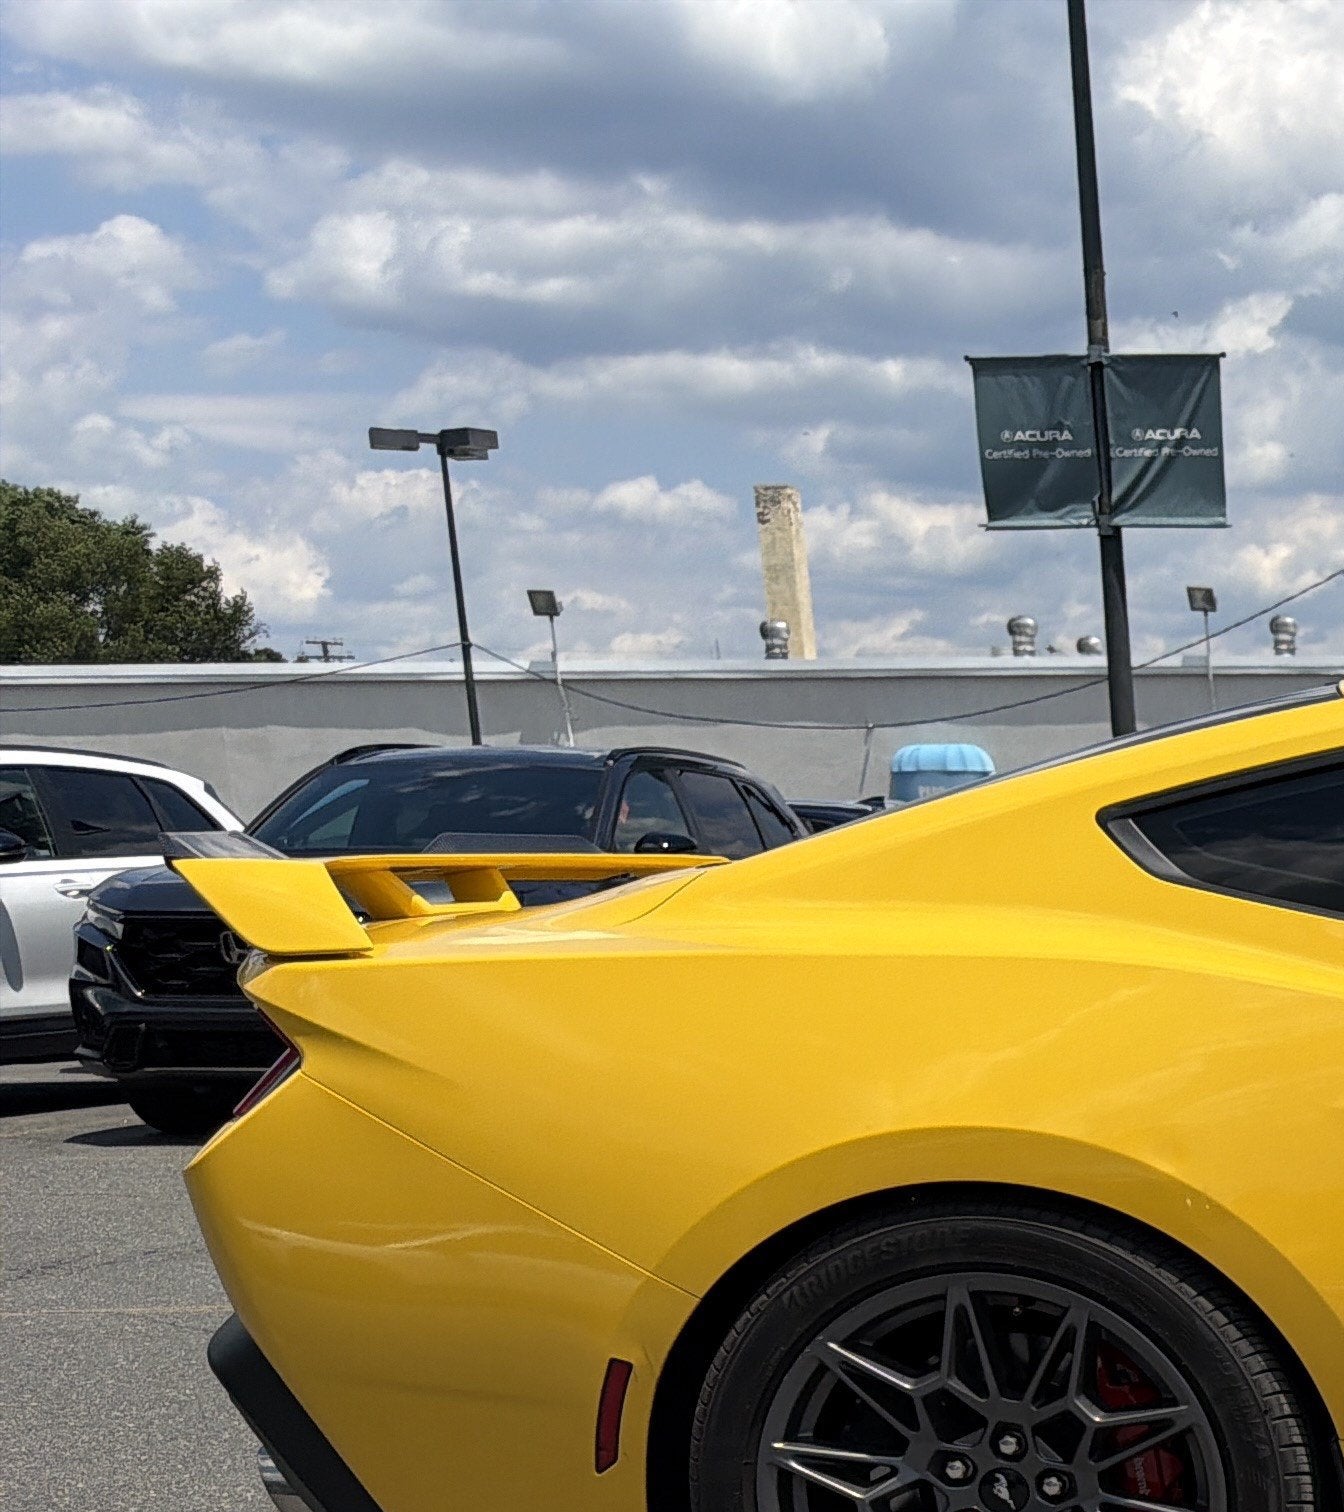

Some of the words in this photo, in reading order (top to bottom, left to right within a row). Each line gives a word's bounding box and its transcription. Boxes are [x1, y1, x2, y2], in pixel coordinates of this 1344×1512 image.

[1014, 430, 1073, 441] ACURA
[1144, 428, 1201, 440] ACURA
[984, 448, 1030, 459] Certified
